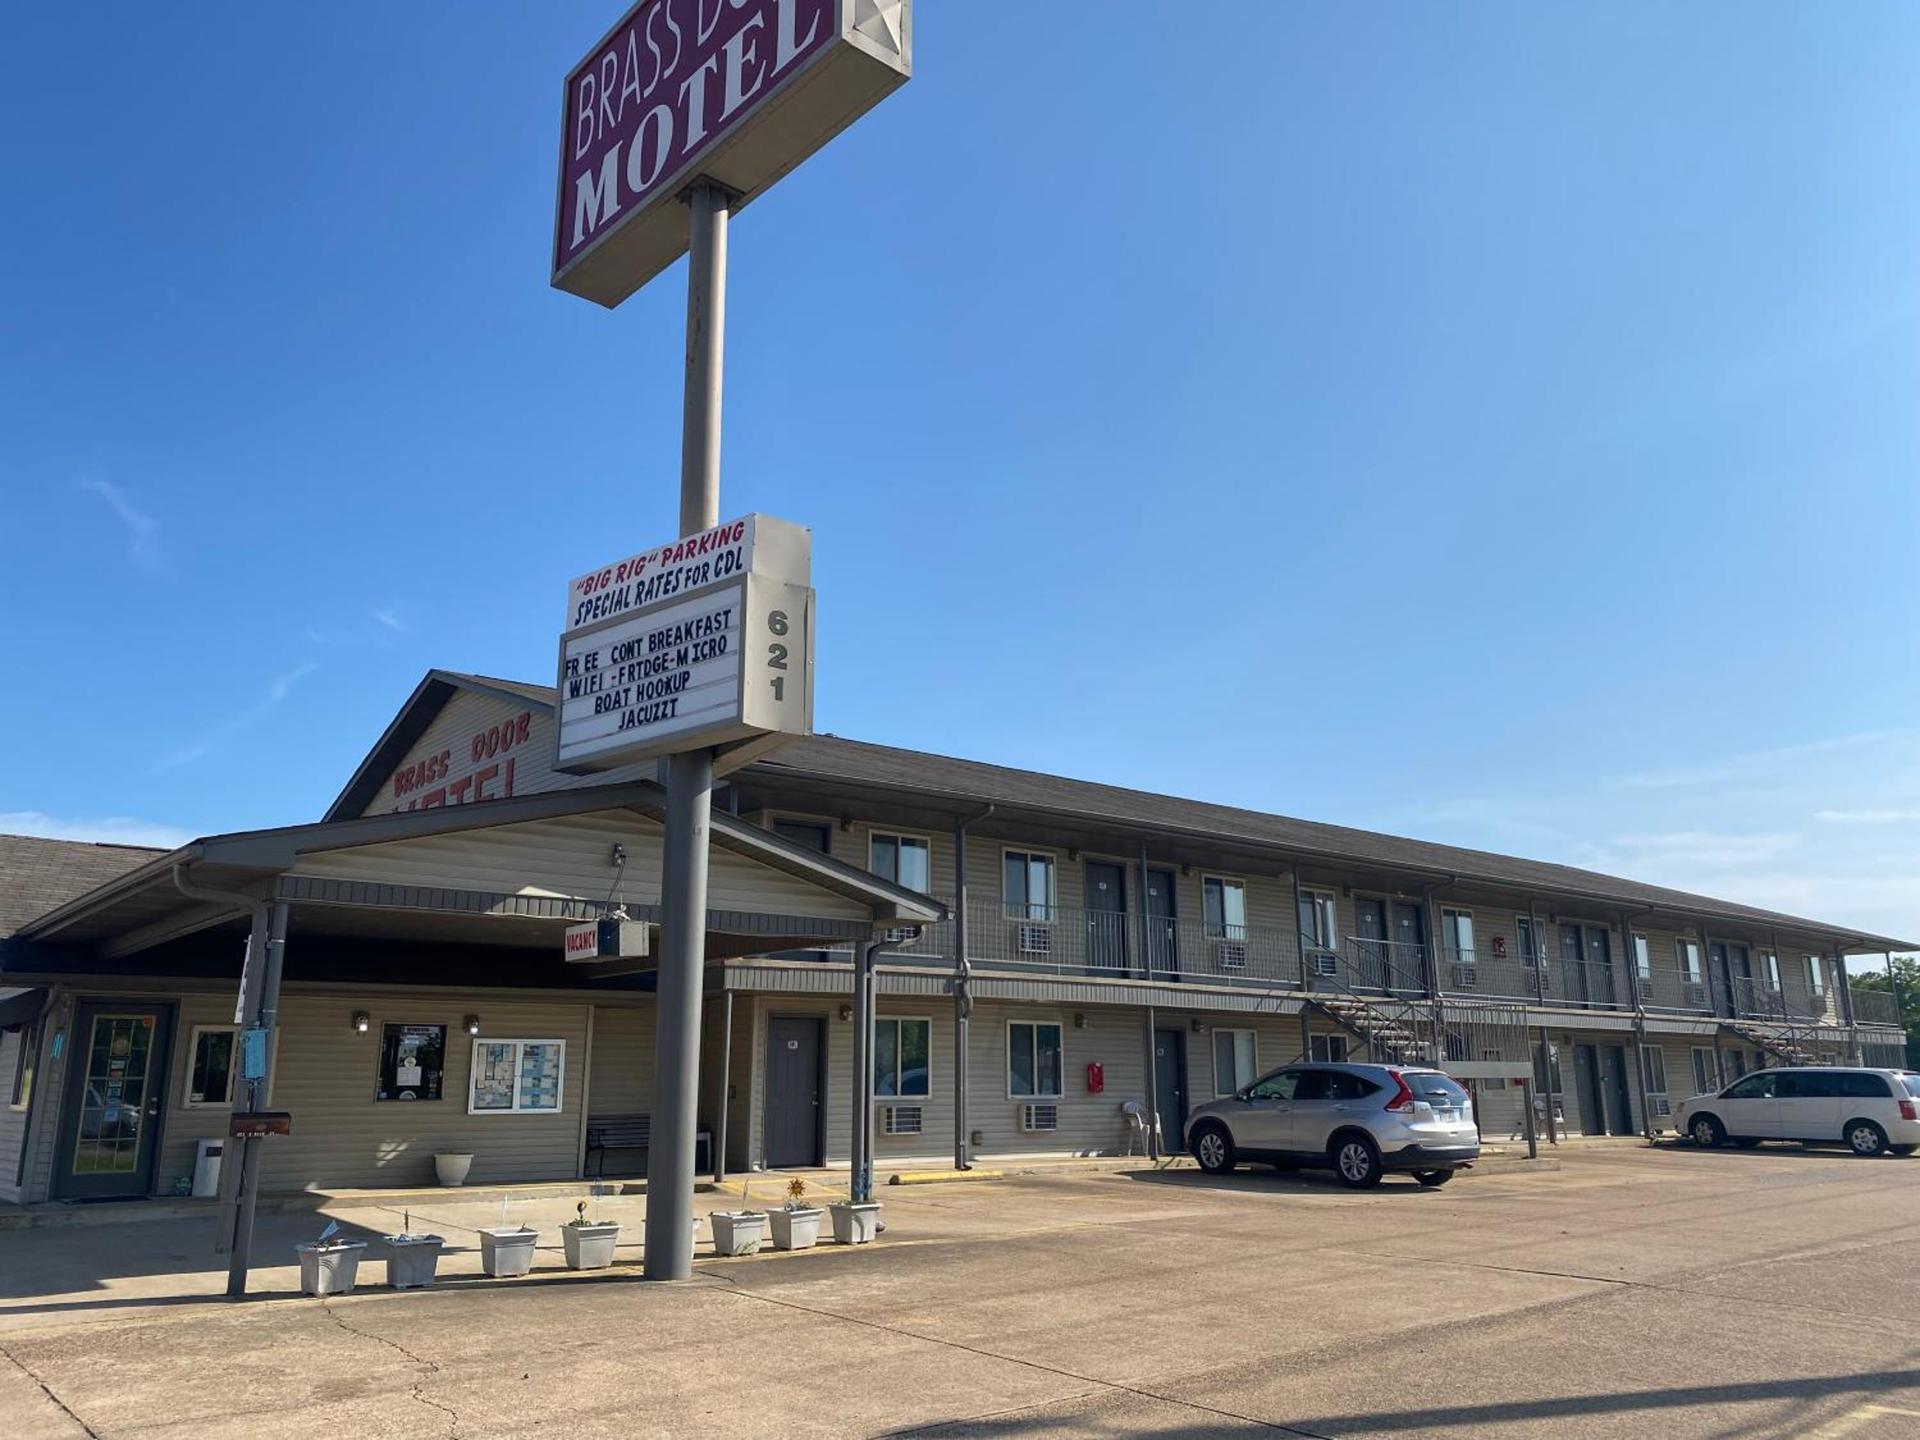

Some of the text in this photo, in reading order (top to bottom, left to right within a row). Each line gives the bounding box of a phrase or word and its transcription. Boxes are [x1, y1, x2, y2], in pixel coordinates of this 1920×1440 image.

[575, 0, 682, 161] BRASS
[569, 0, 821, 251] MOTEL
[661, 521, 745, 568] PARKING
[574, 546, 743, 627] SPECIAL RATES FOR CDL
[611, 638, 643, 664] CONT
[648, 609, 732, 652] BREAKFAST
[569, 673, 603, 699] WIFI
[594, 670, 690, 715] BOAT HOOKUP
[394, 750, 450, 798] BRASS
[470, 711, 531, 763] DOOR
[566, 930, 597, 953] VACANCY
